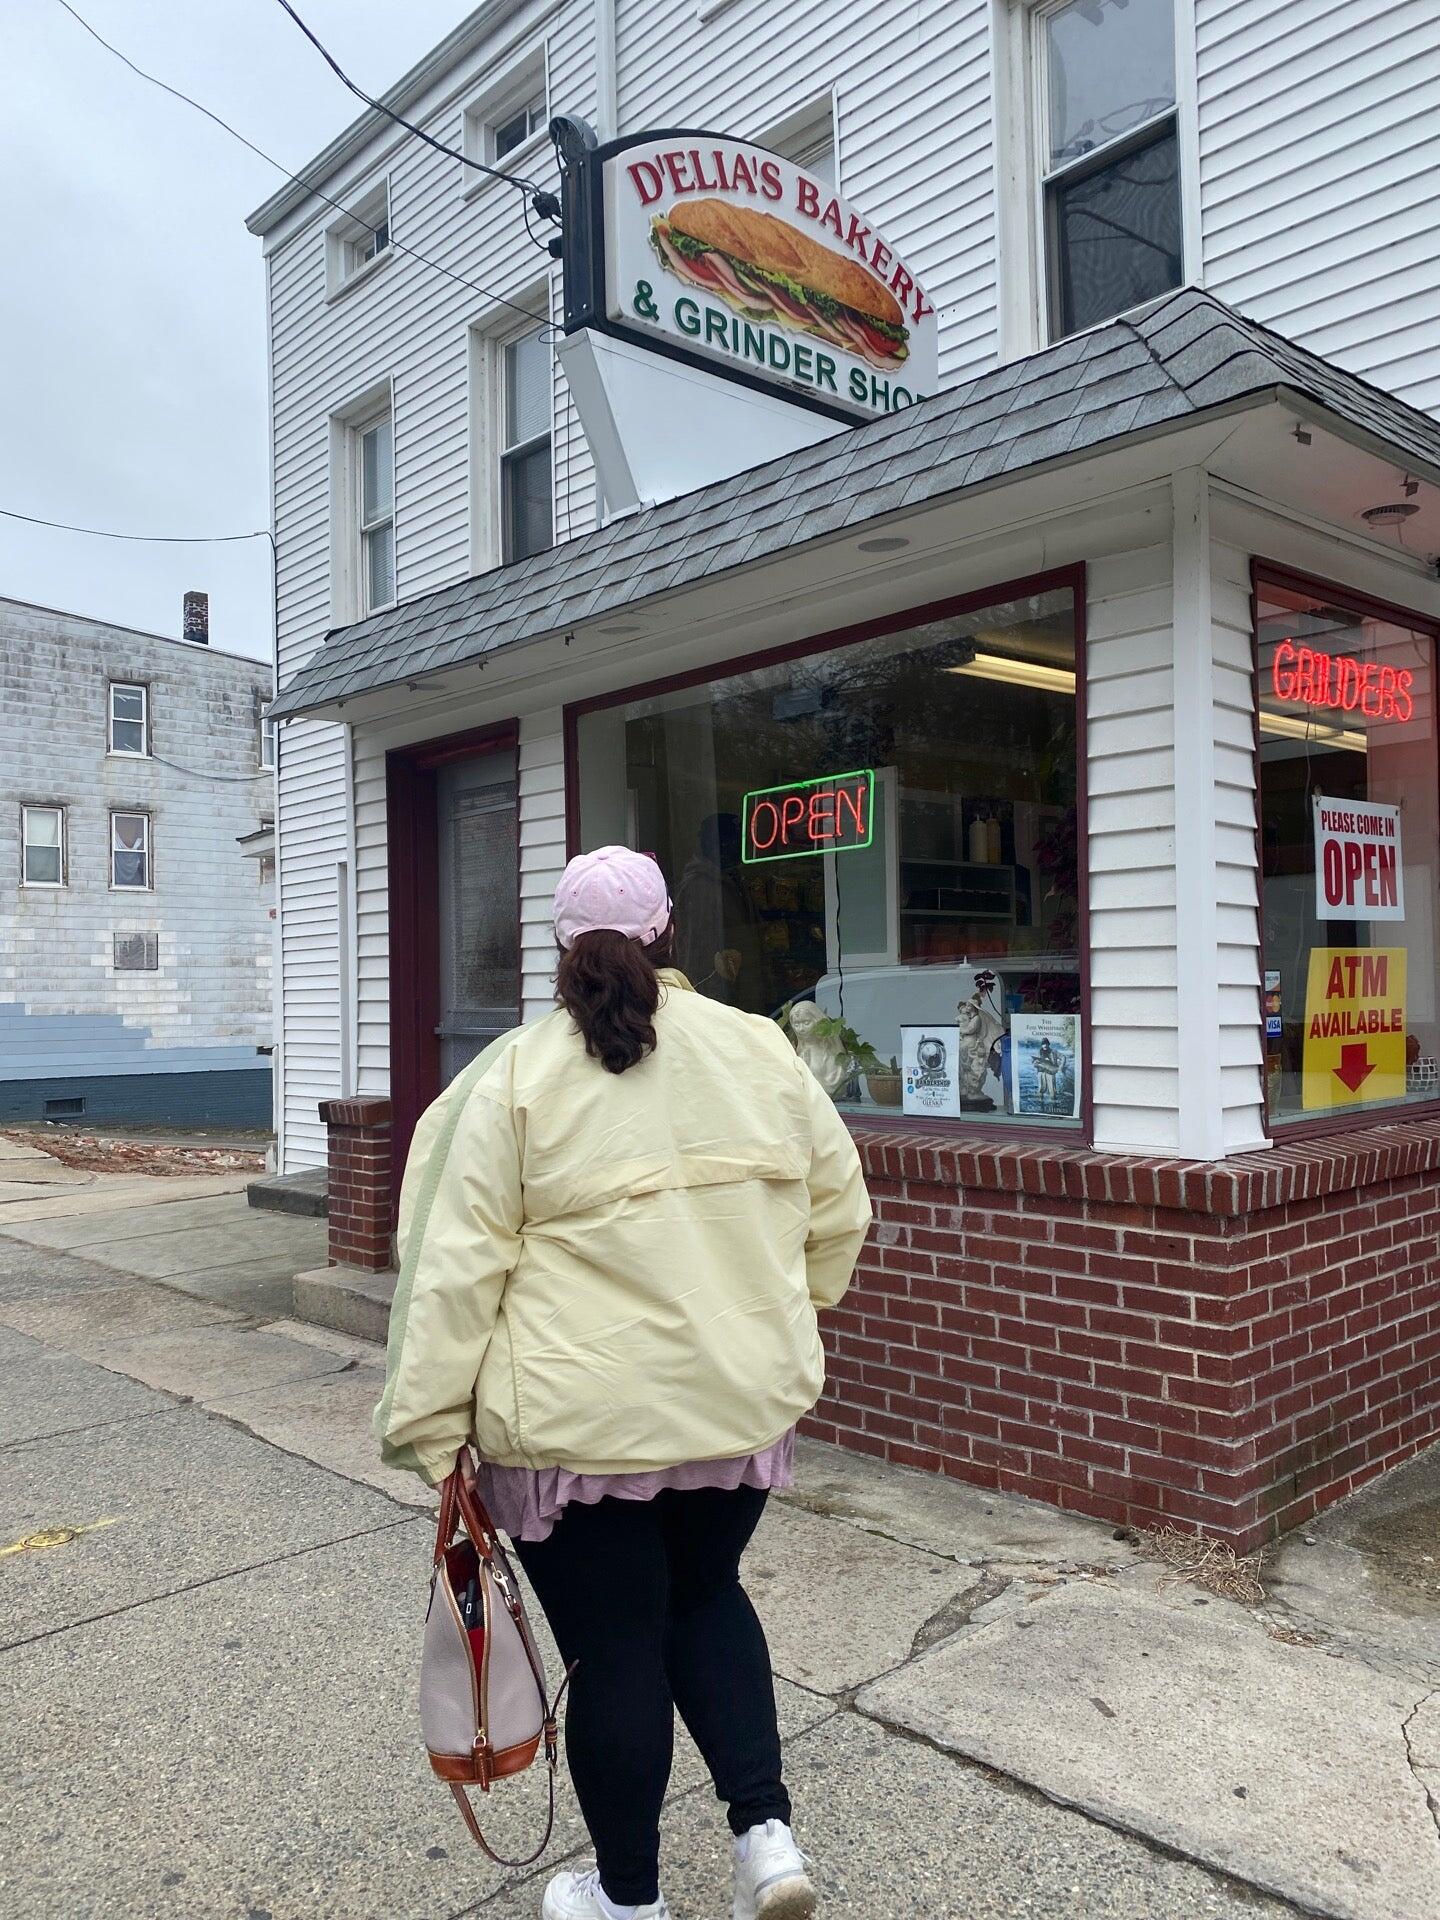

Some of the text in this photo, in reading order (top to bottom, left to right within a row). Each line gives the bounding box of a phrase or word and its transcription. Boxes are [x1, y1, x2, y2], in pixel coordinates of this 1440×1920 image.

[627, 149, 934, 325] D'ELIA'S BAKERY
[633, 279, 927, 411] & GRINDER SHO
[1273, 638, 1414, 722] GRINDERS
[750, 786, 867, 849] OPEN
[1321, 810, 1395, 837] PLEASE COME IN
[1323, 839, 1398, 906] OPEN
[1325, 955, 1388, 999] ATM
[1267, 1019, 1281, 1030] VISA
[1309, 1008, 1403, 1039] AVAILABLE
